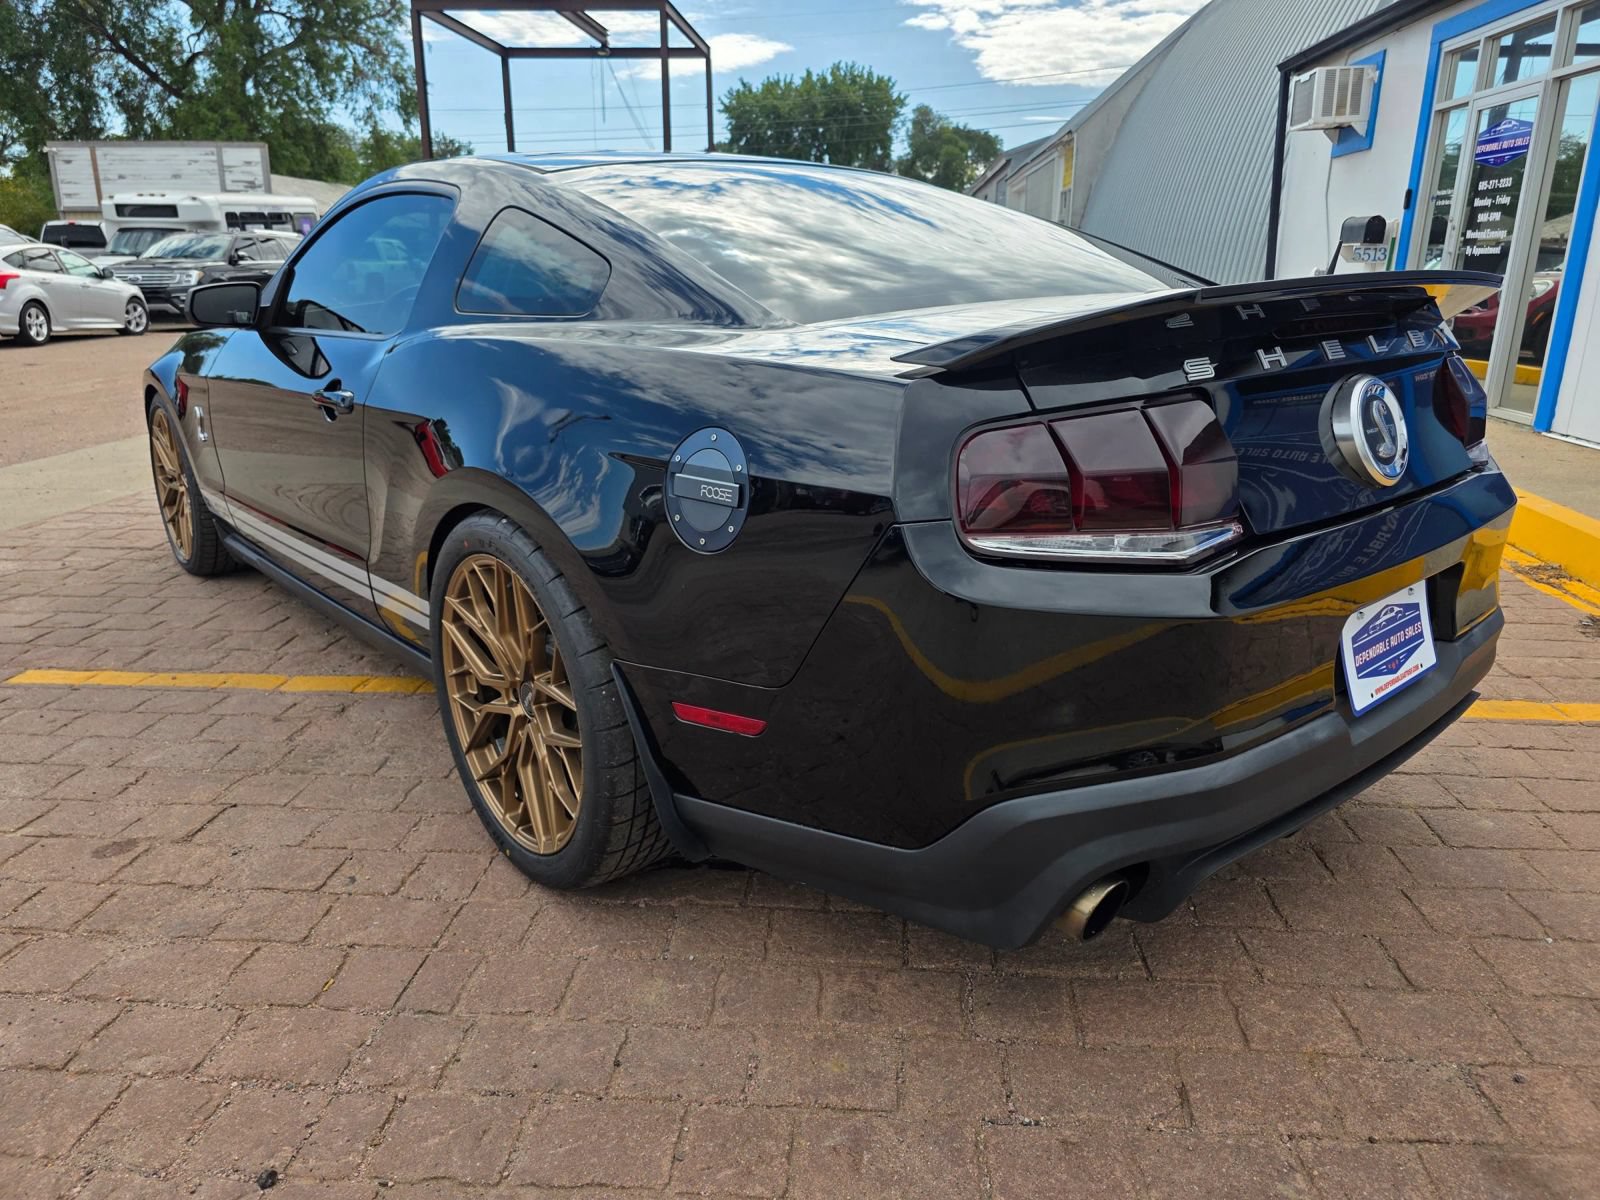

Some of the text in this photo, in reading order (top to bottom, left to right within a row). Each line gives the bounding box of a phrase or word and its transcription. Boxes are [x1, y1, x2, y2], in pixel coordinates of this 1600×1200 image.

[1502, 139, 1515, 149] AUTO
[1515, 136, 1530, 147] SALES
[1474, 196, 1492, 207] Monday
[1495, 194, 1511, 206] Friday
[1352, 247, 1387, 262] 5513
[1465, 246, 1472, 257] By
[700, 484, 733, 502] FOOSE
[1354, 622, 1422, 667] DEPENDABLE AUTO SALES
